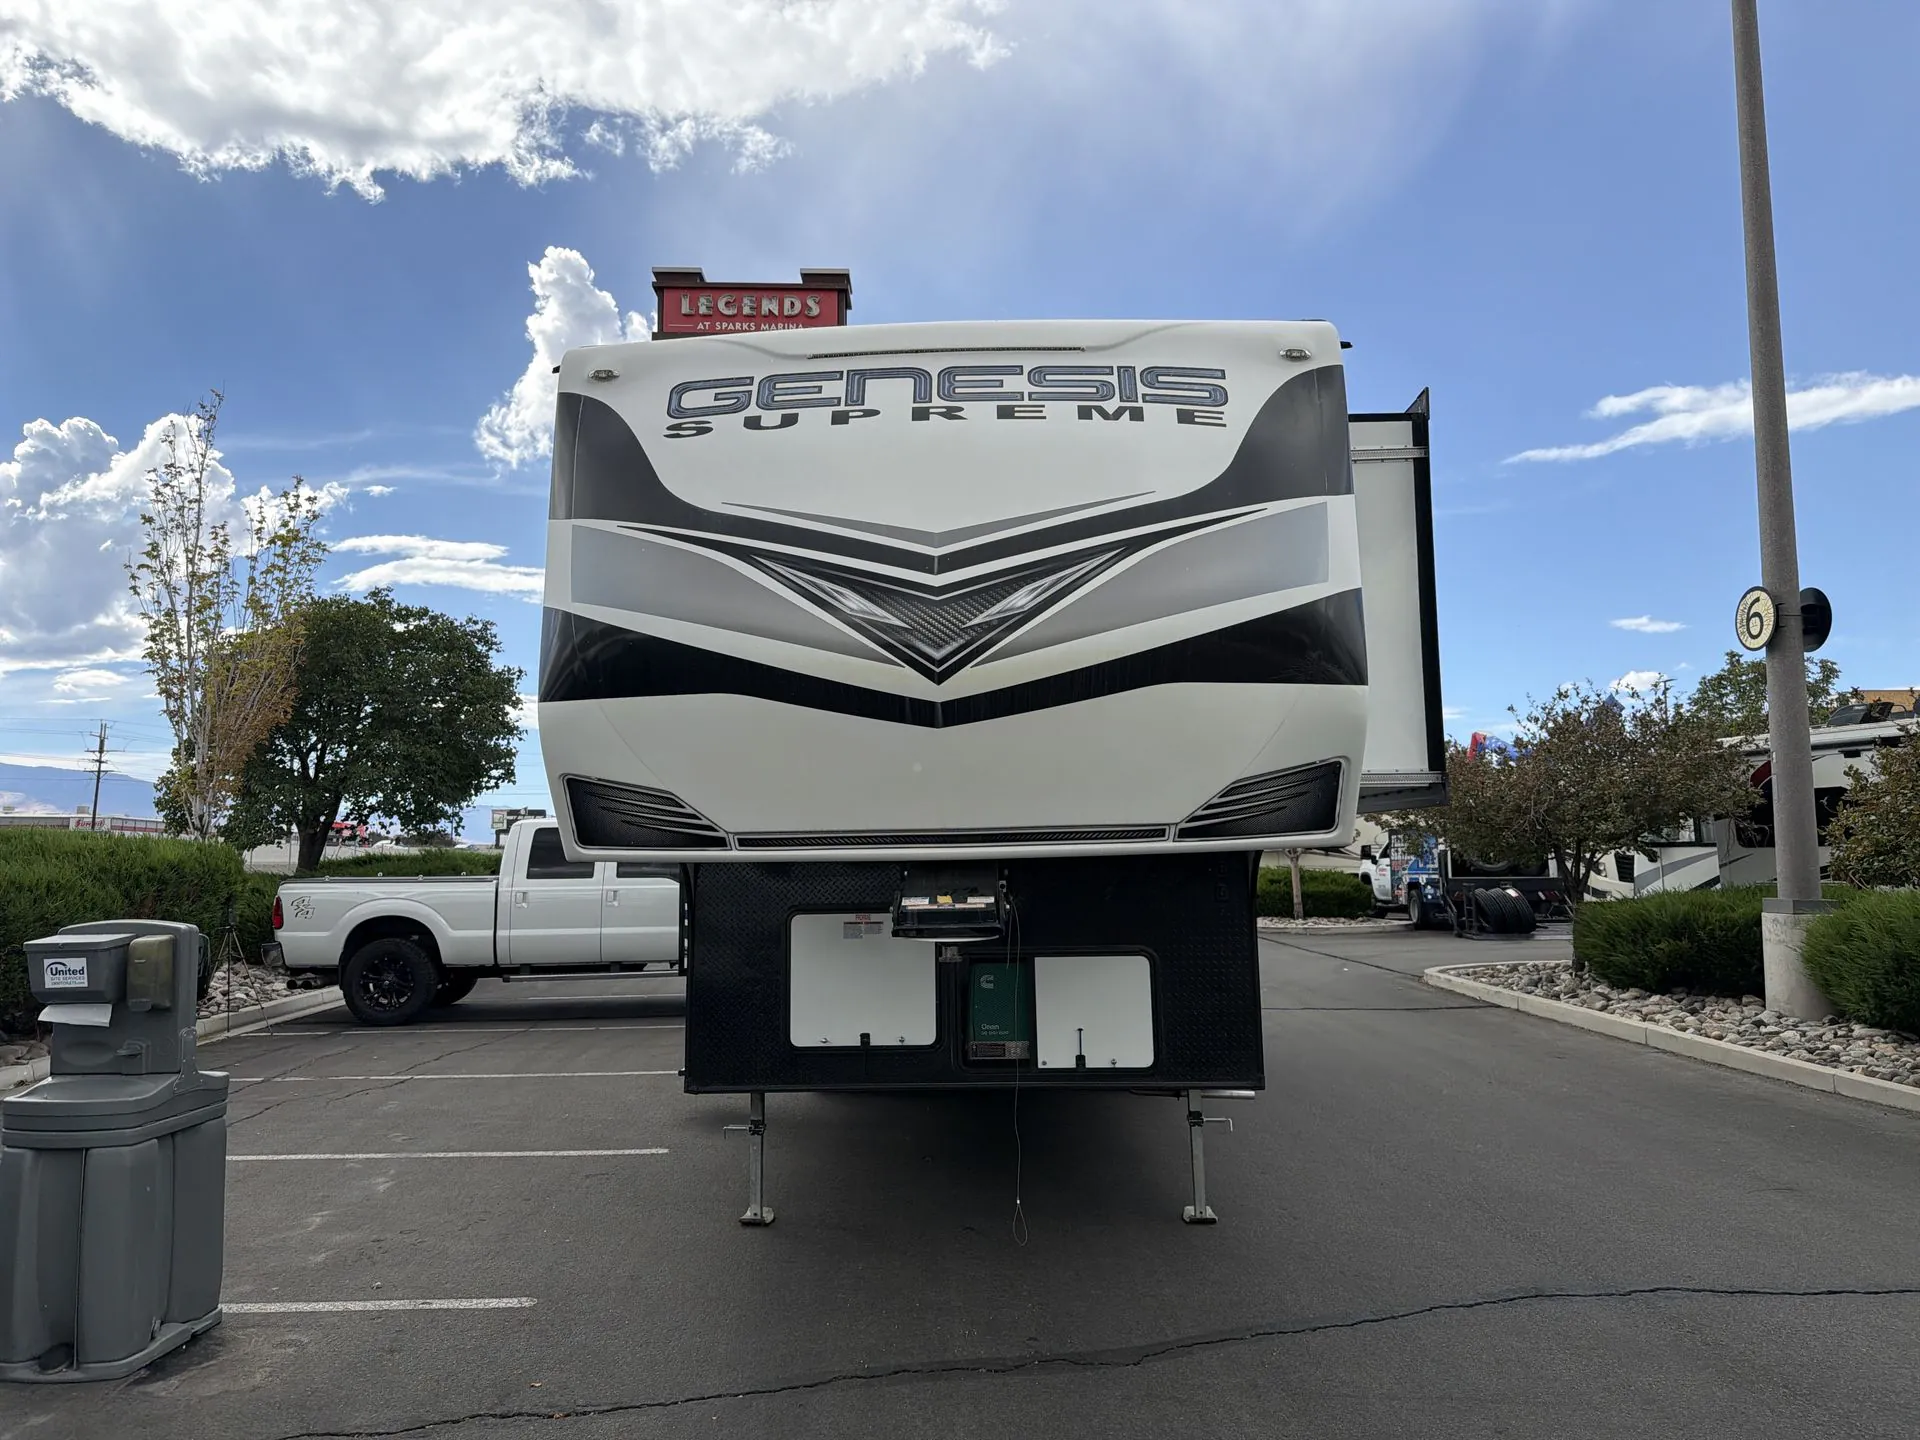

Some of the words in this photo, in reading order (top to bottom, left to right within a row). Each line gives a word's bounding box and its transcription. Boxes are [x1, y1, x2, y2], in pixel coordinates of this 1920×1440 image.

[681, 294, 821, 317] LEGENDS
[697, 321, 710, 331] AT
[715, 321, 756, 331] SPARKS
[666, 364, 1230, 420] GENESIS
[662, 403, 1229, 440] SUPREME
[1746, 595, 1764, 640] 6
[50, 966, 85, 976] United
